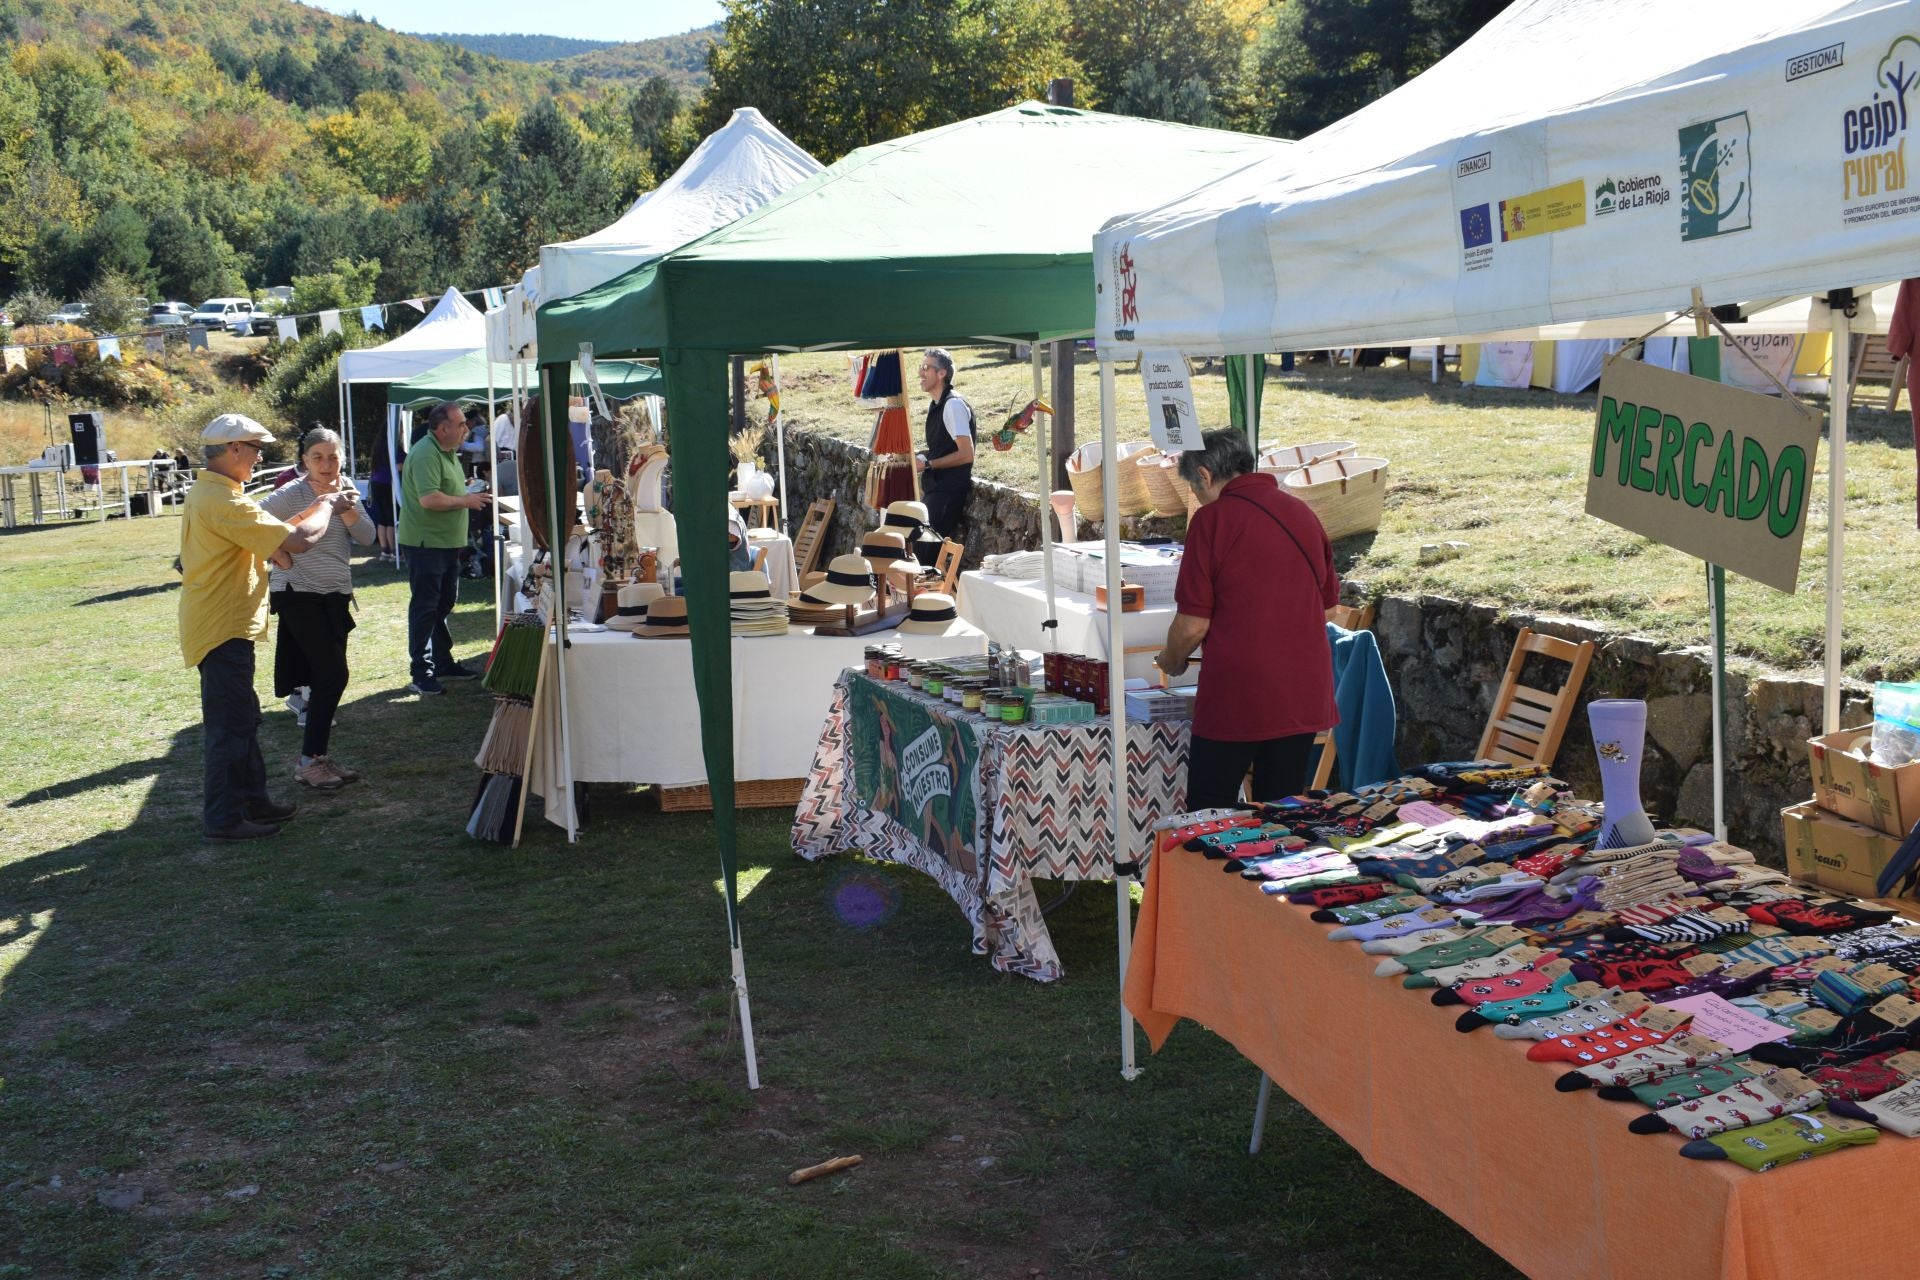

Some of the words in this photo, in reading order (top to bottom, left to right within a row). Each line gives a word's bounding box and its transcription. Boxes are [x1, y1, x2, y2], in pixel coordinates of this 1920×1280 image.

[1790, 49, 1838, 76] GESTIONA
[1844, 92, 1898, 154] ceip
[1460, 157, 1487, 175] FINANCIA
[1843, 137, 1906, 201] rural
[1618, 175, 1661, 194] Gobierno
[1619, 197, 1631, 211] de
[1632, 194, 1643, 208] La
[1646, 187, 1670, 206] Rioja
[1680, 154, 1690, 237] LEADER
[1844, 207, 1864, 216] CENTRO
[1865, 201, 1889, 212] EUROPEO
[1890, 199, 1898, 207] DE
[1880, 210, 1890, 218] DEL
[1891, 207, 1908, 216] MEDIO
[1593, 395, 1806, 539] MERCADO
[905, 732, 940, 774] CONSUME
[912, 769, 950, 811] NUESTRO
